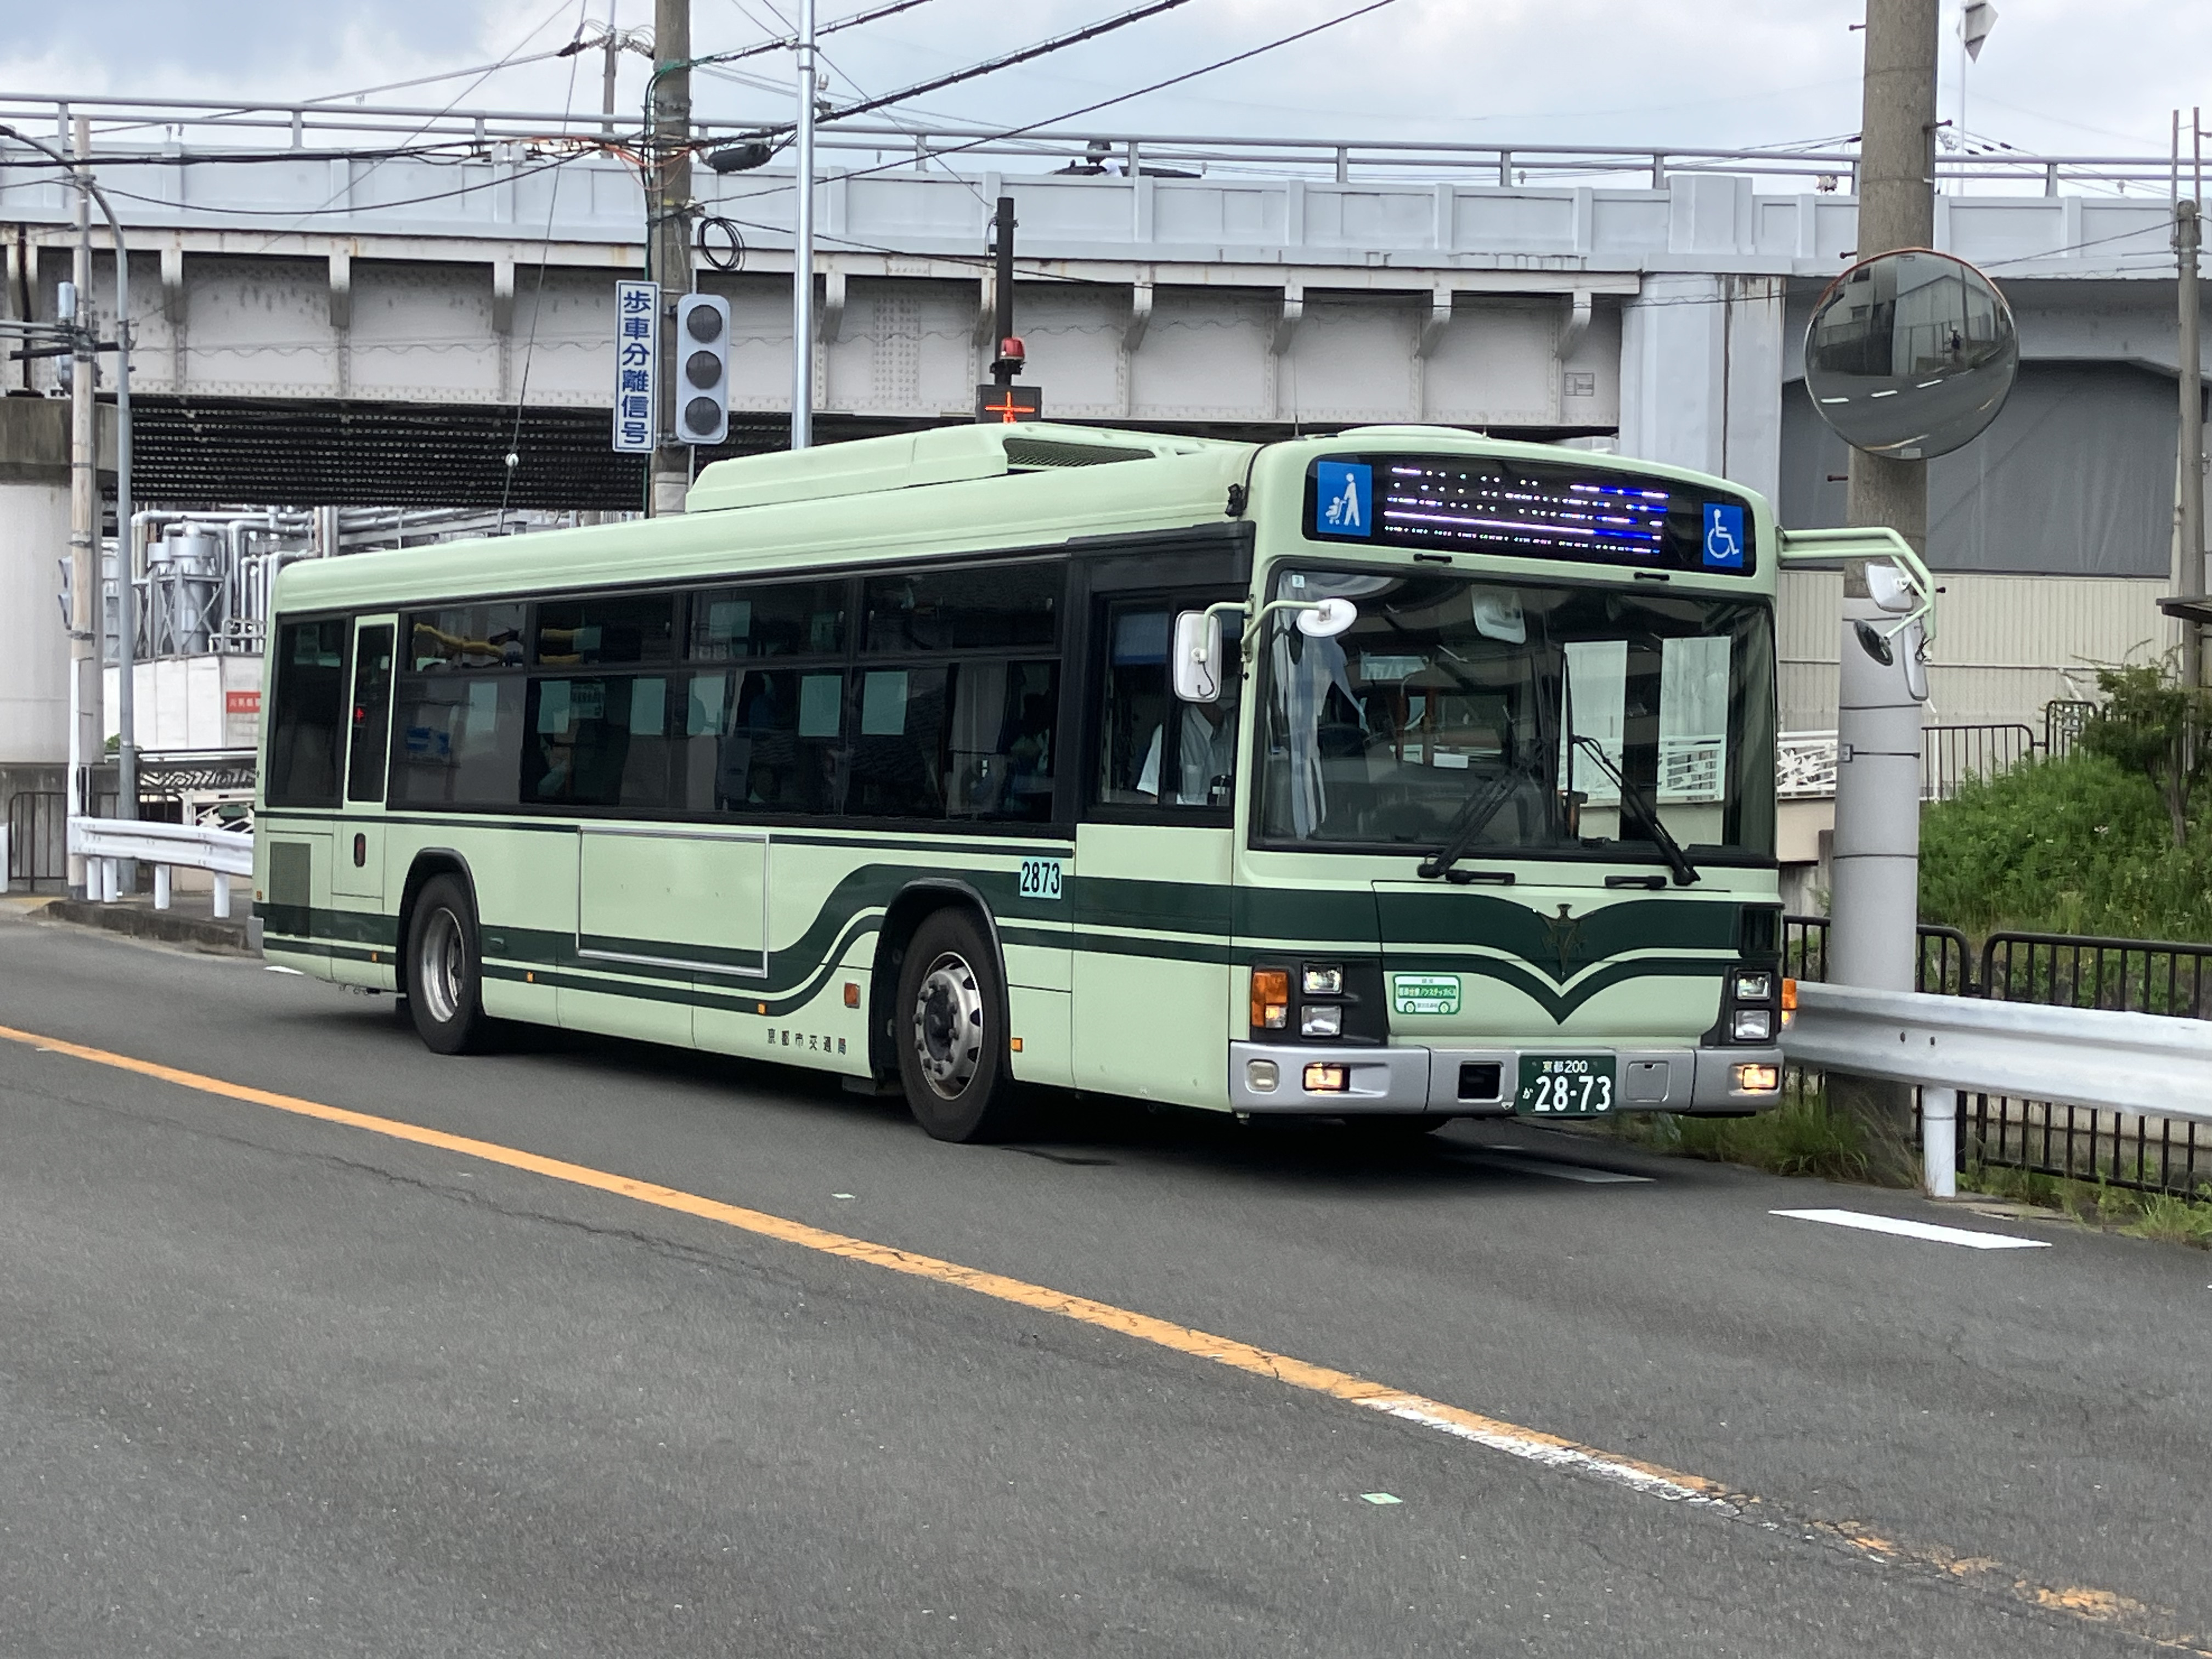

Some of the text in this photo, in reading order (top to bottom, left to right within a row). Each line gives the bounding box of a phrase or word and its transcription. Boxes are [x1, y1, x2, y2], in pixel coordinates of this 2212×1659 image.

[621, 290, 651, 443] 歩車分離信号
[1022, 861, 1059, 894] 2873
